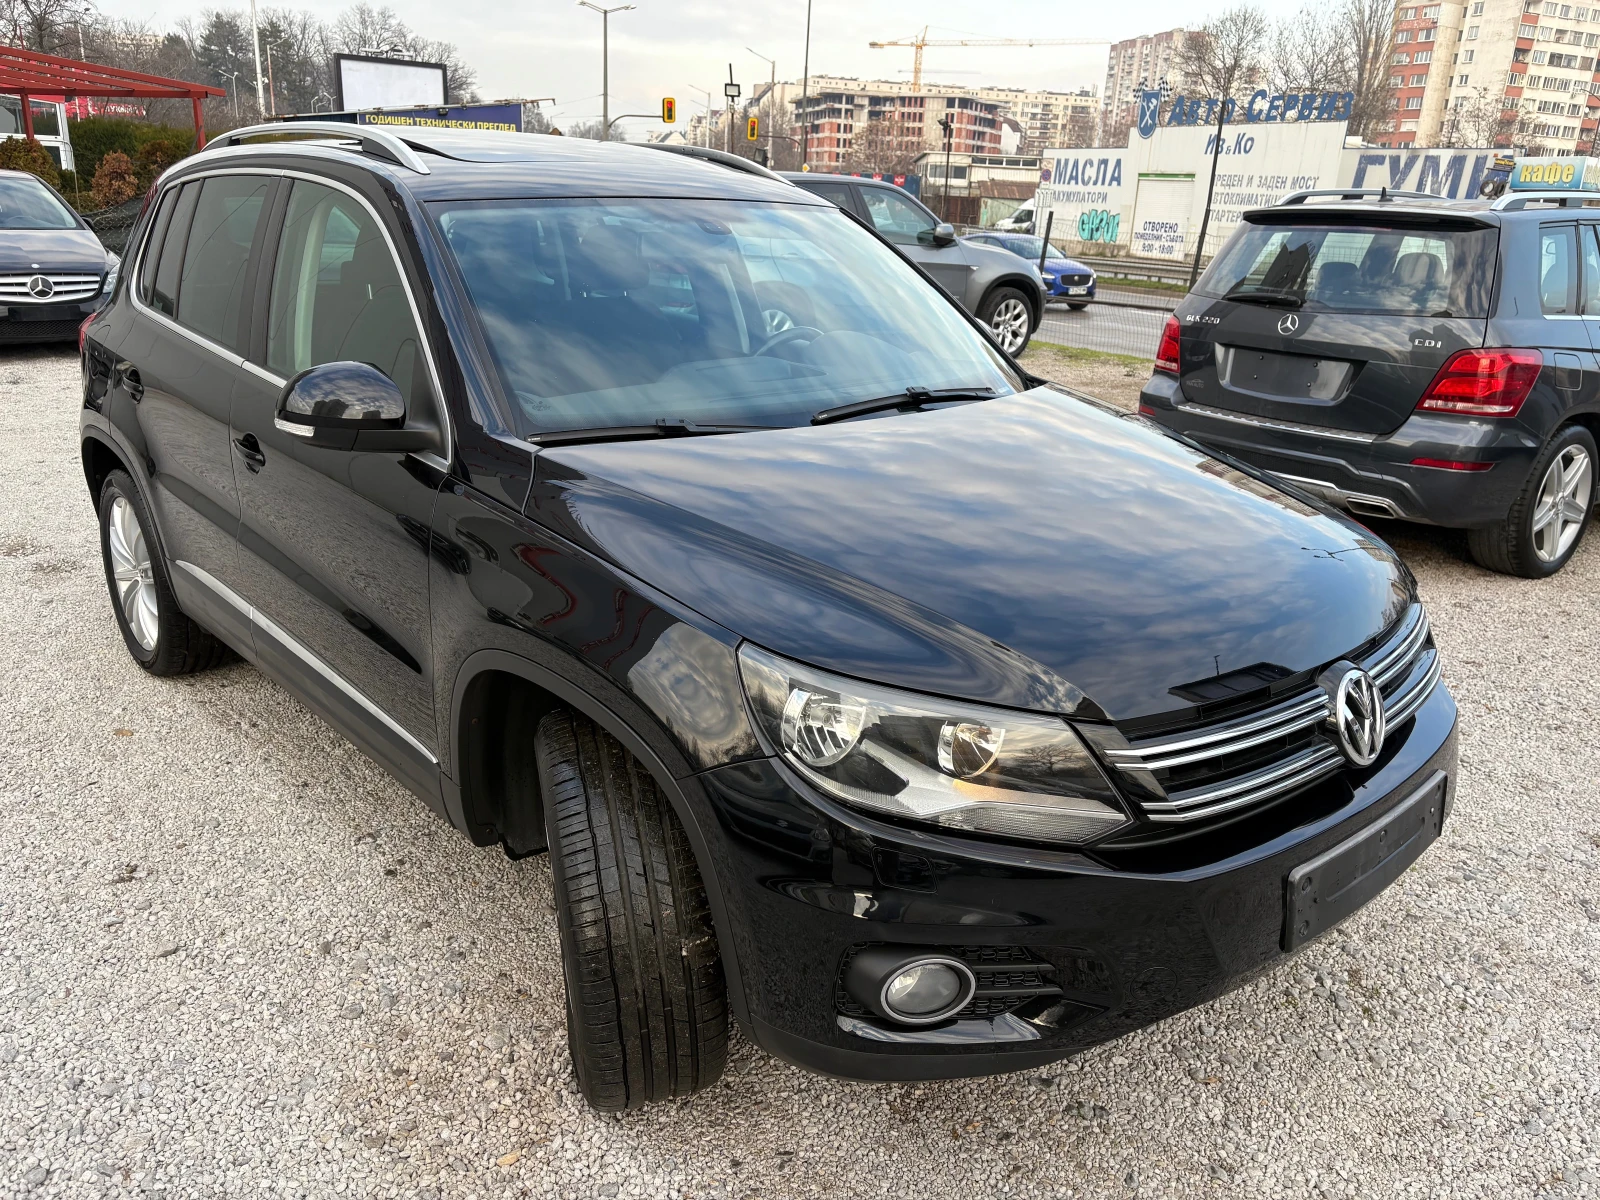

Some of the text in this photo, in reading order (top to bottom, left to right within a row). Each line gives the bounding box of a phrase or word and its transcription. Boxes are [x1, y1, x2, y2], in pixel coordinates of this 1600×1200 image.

[366, 114, 516, 132] ГОДИШЕН ТЕХНИЧЕСКИ ПРЕГЛЕД
[1053, 157, 1122, 187] МАСЛА
[1520, 162, 1575, 185] кафе
[1213, 174, 1319, 191] РЕДЕН И ЗАДЕН МОСТ
[1143, 221, 1178, 233] ОТВОРЕНО
[1186, 314, 1220, 324] GLK 220
[1414, 338, 1442, 348] CDI
